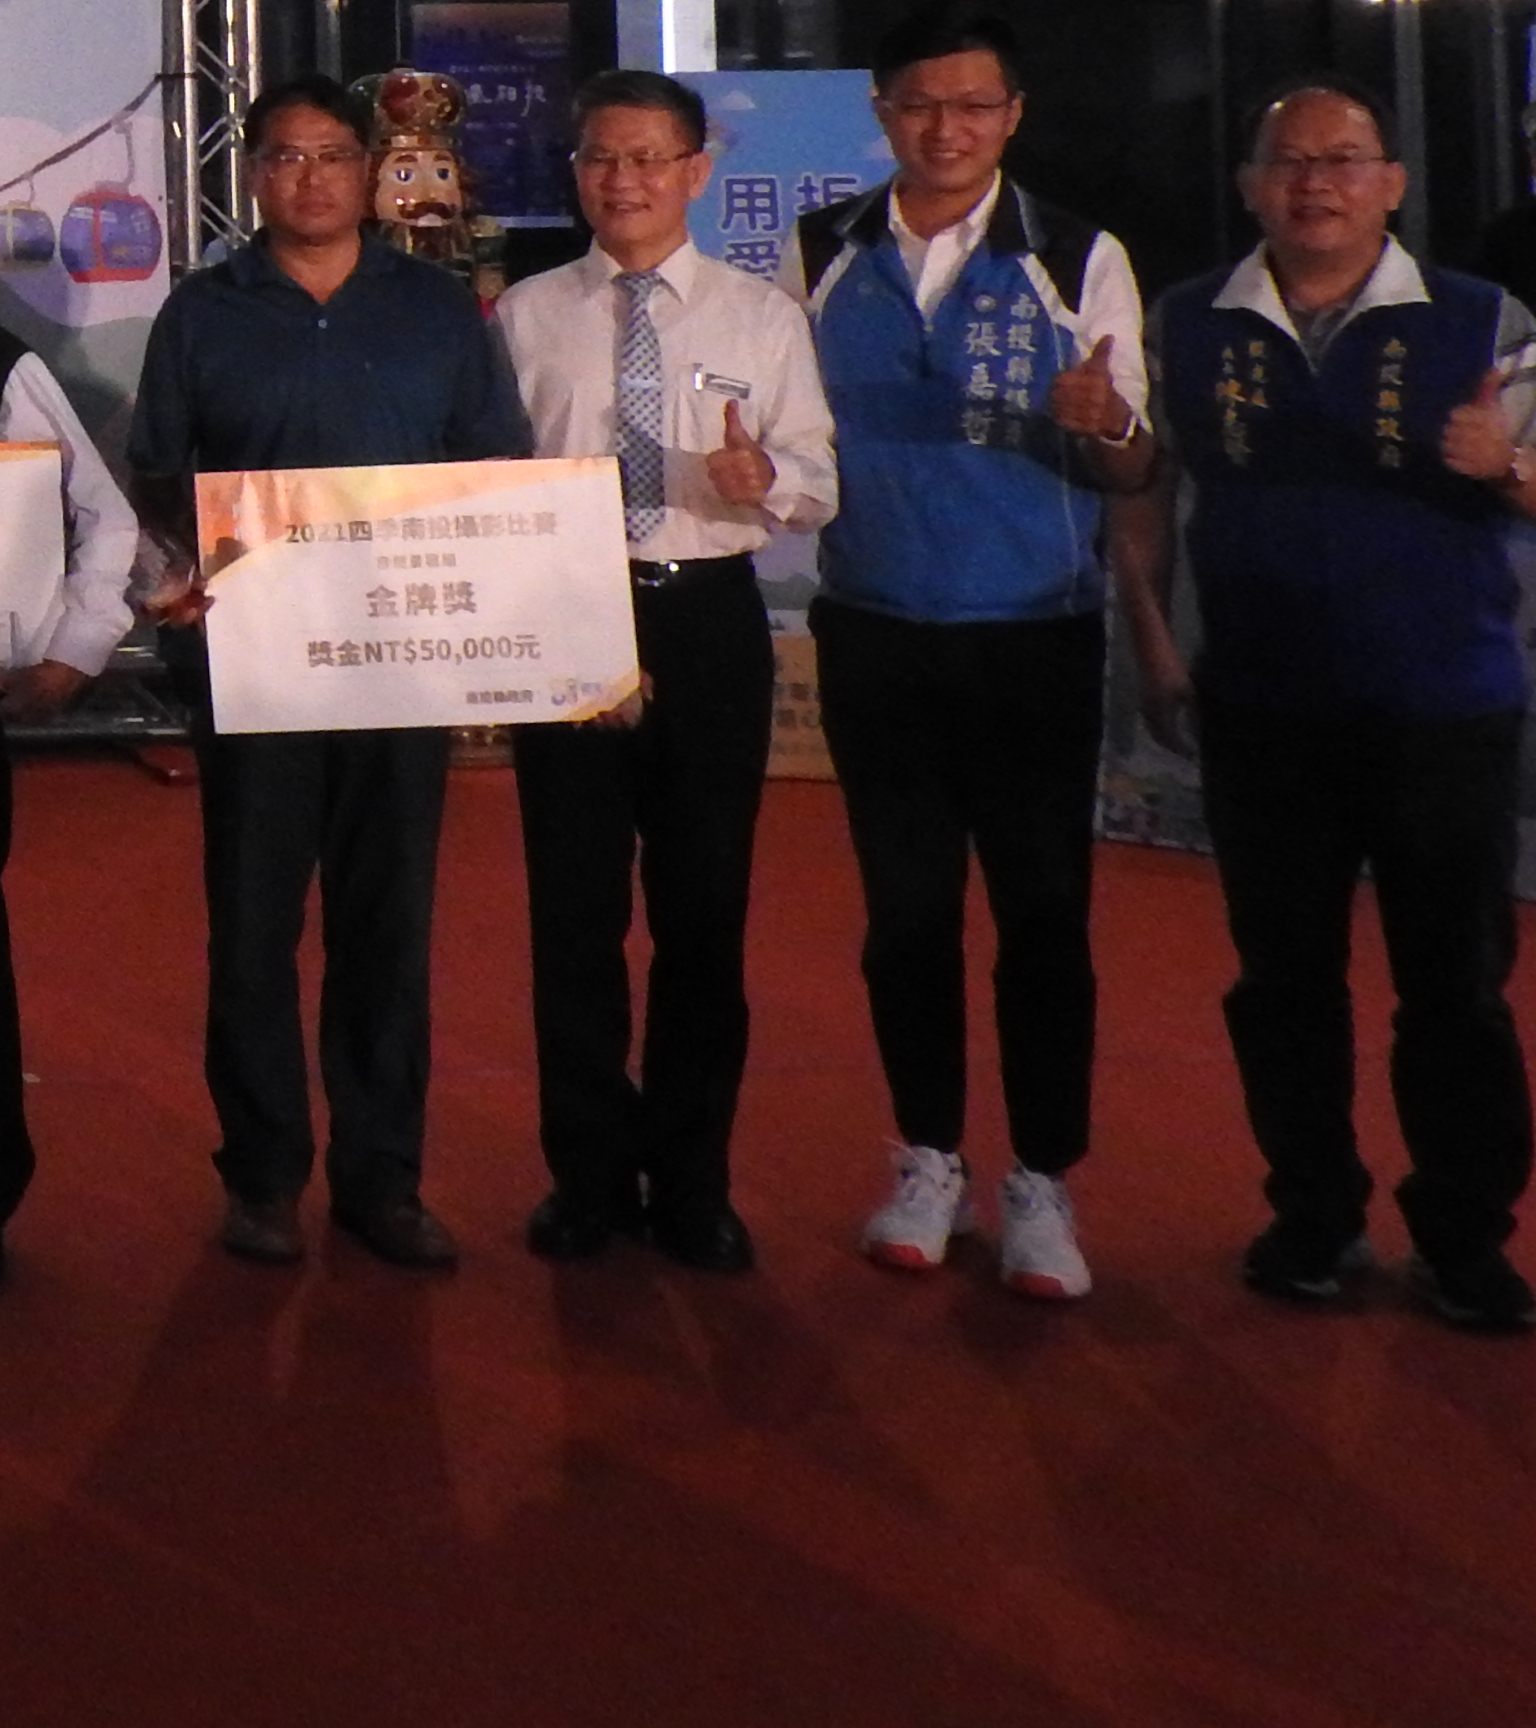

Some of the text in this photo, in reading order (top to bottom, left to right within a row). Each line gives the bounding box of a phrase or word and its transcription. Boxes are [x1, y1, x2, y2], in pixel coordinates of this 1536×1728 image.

[366, 581, 477, 619] 金牌獎
[308, 634, 543, 669] 獎金NT$50,000元
